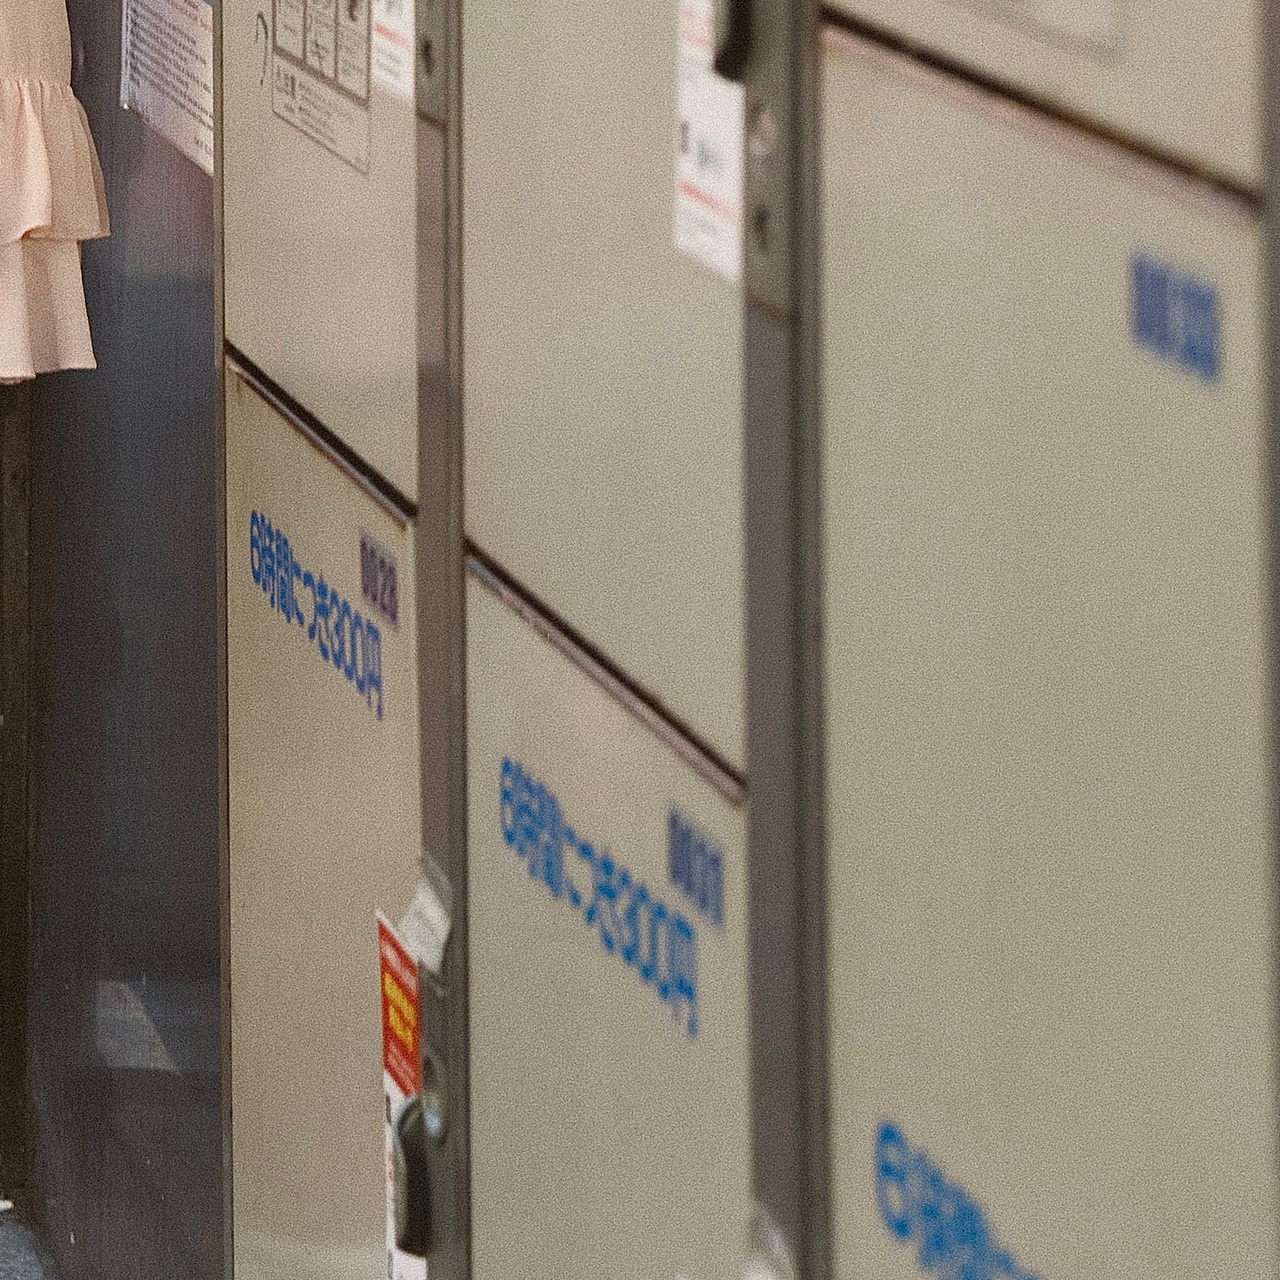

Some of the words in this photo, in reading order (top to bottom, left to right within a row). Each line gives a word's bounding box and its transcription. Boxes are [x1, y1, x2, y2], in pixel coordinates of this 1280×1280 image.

[250, 507, 383, 721] 6時間につき300円
